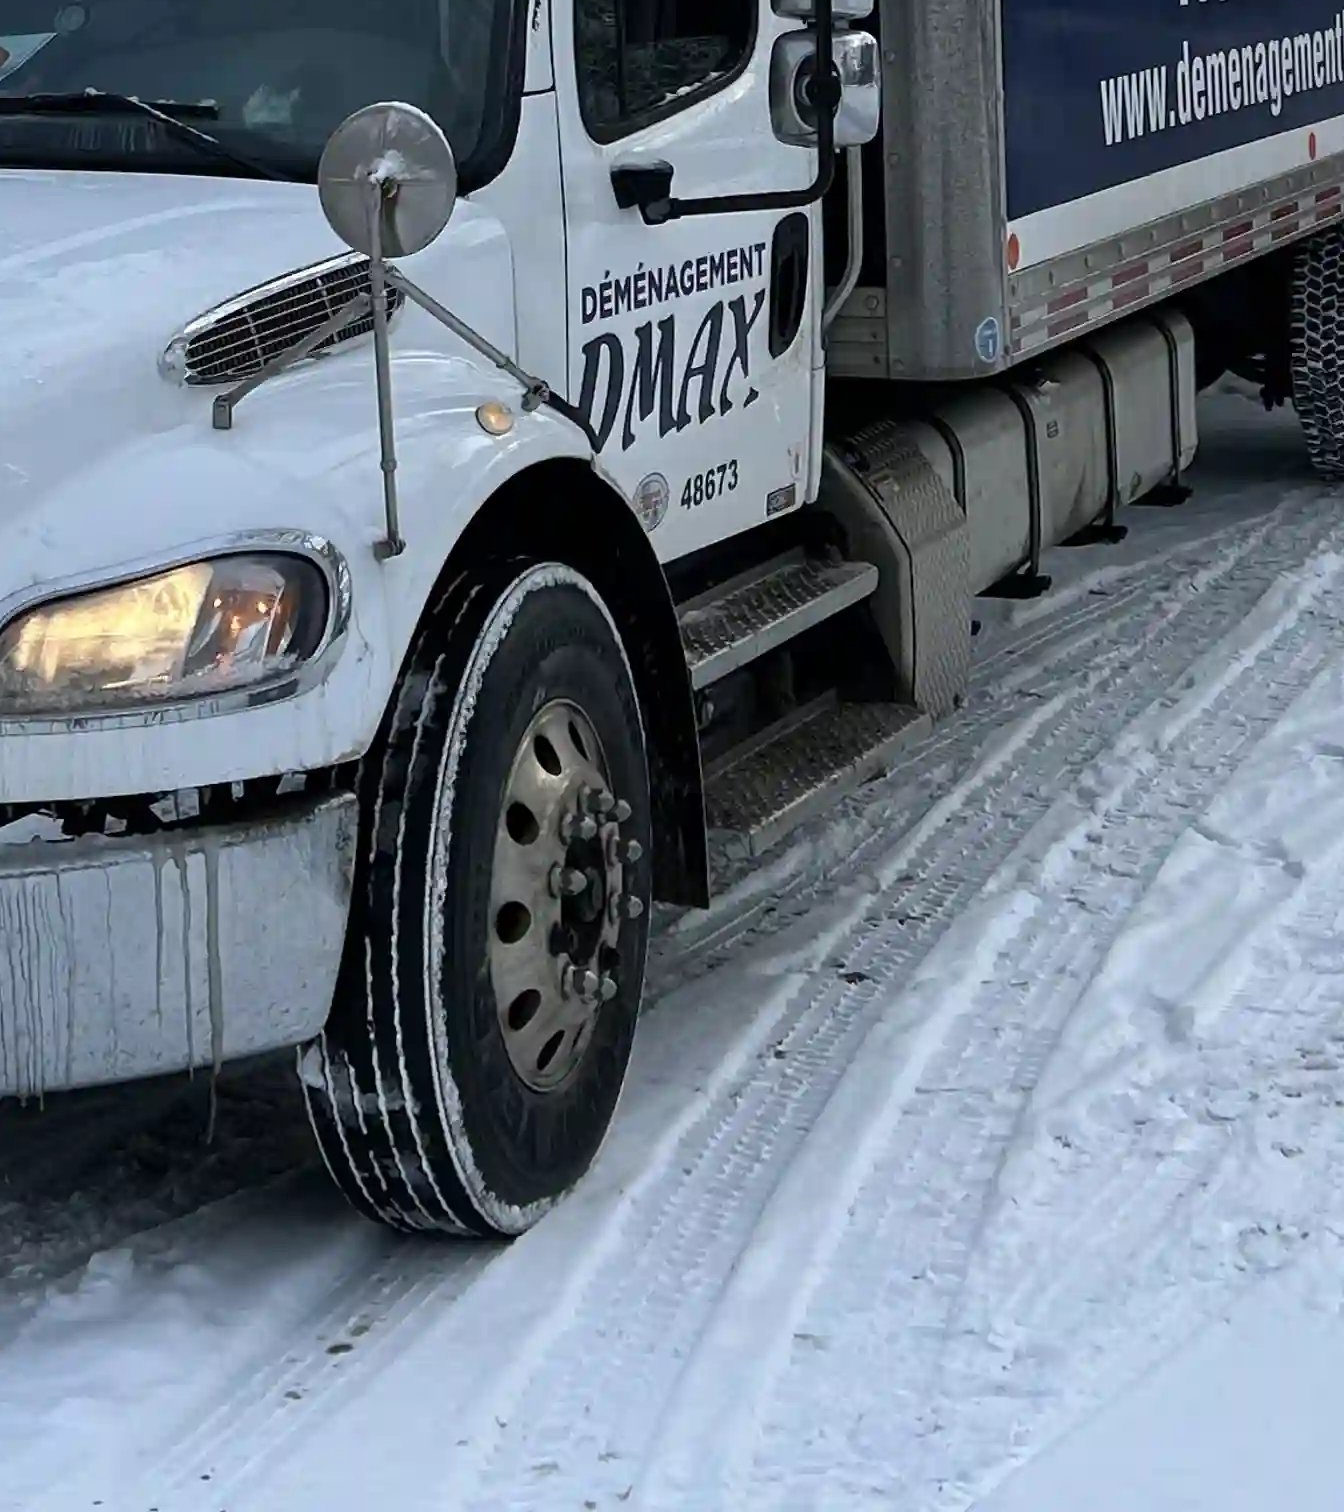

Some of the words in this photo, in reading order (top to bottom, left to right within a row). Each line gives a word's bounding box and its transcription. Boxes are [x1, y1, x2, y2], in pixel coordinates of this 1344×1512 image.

[582, 242, 766, 325] DÉMÉNAGEMENT
[578, 288, 766, 454] DMAX
[680, 459, 739, 510] 48673
